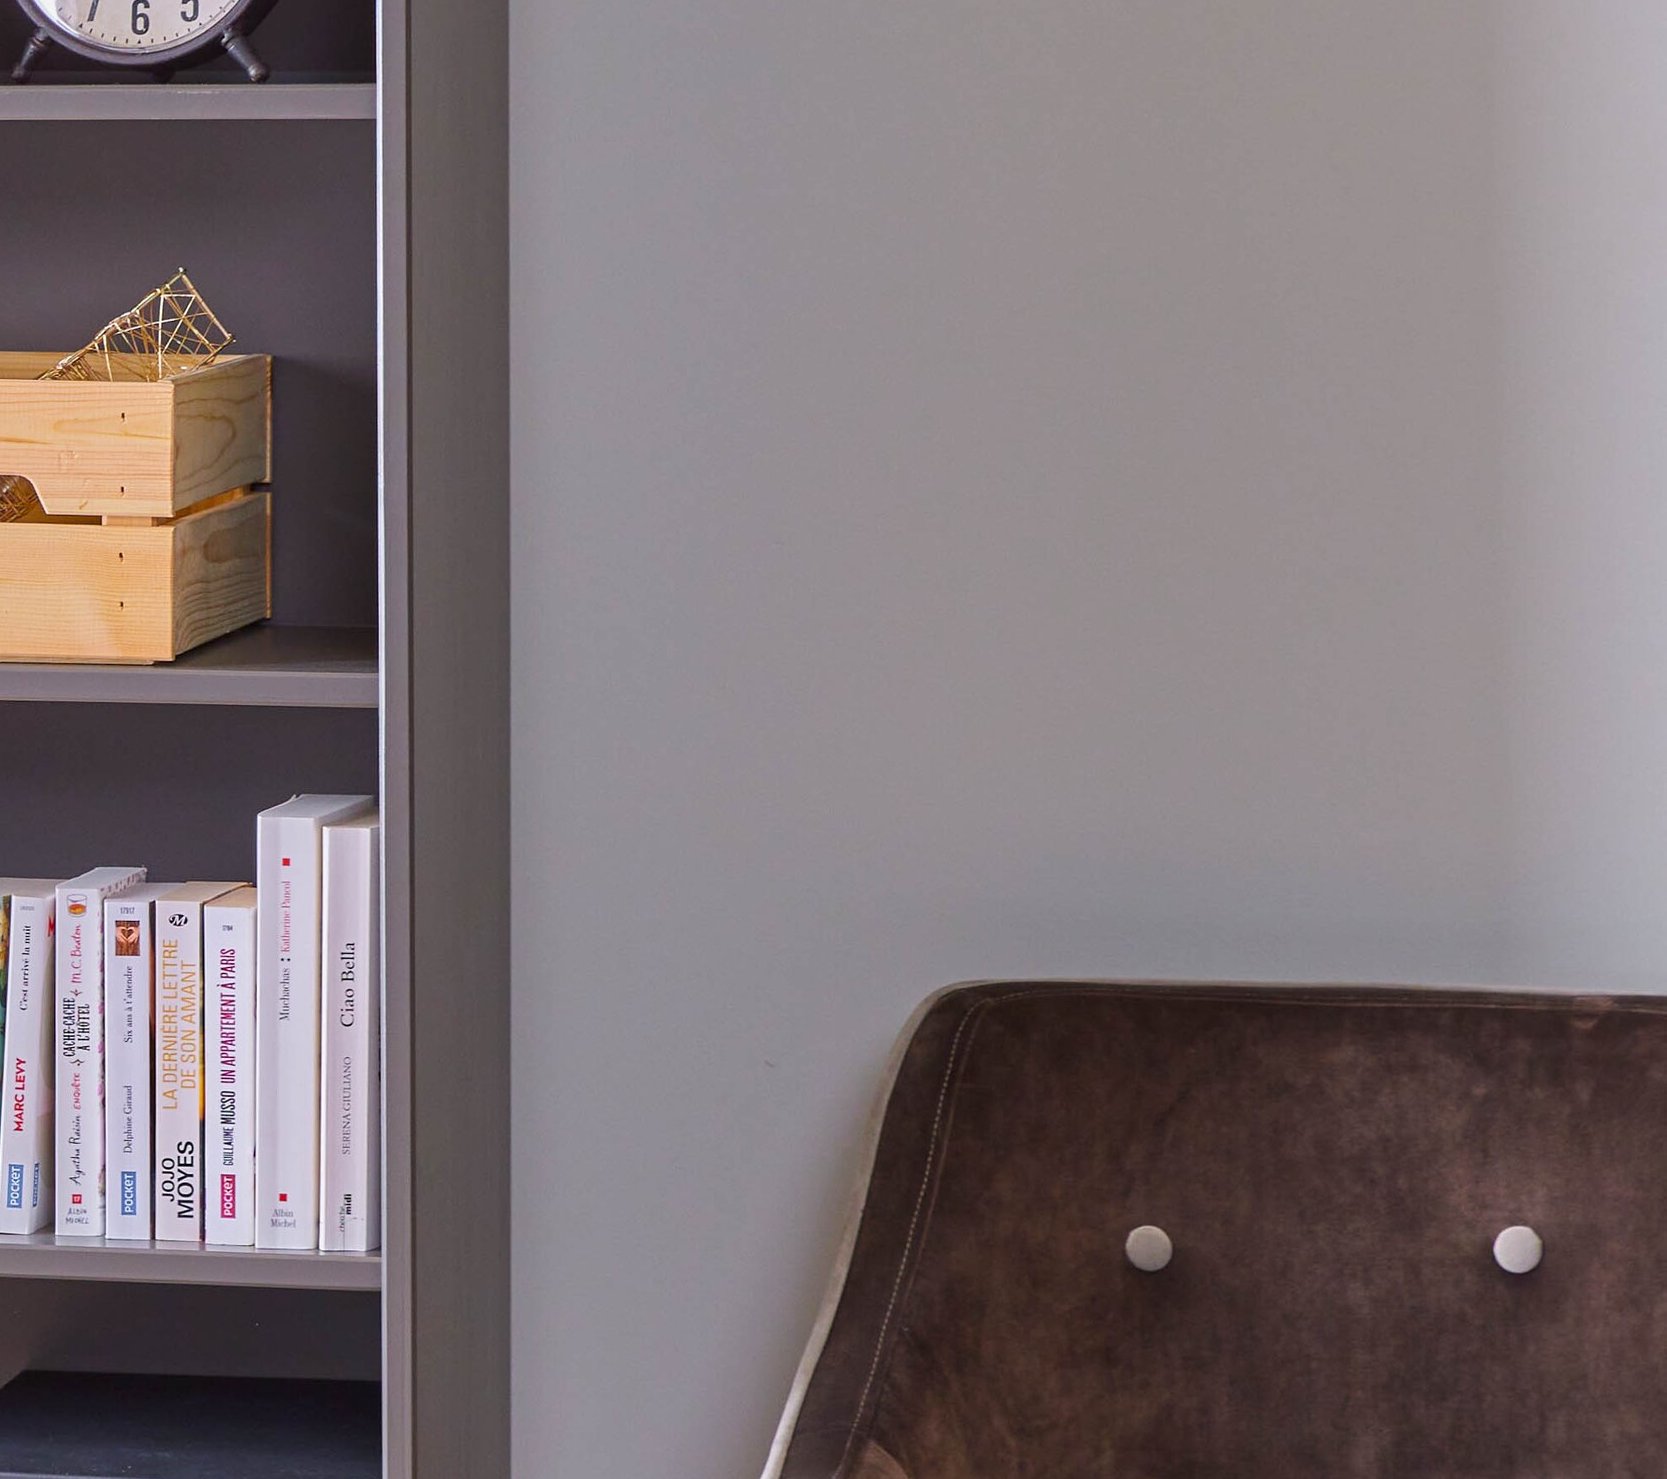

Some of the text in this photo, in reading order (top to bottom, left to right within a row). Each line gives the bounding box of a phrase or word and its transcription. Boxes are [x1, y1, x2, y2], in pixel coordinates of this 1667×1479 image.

[340, 942, 356, 1027] Ciao Bella
[63, 997, 76, 1057] CACHE-CACHE
[161, 939, 178, 1110] LA DERNIÈRE LETTRE
[180, 960, 196, 1090] DE SON AMANT
[217, 948, 236, 1166] GUILLAUME MUSSO UN APPARTEMENT À PARIS
[14, 1057, 26, 1131] MARC LEVY
[123, 1085, 133, 1153] Delphine Giraud
[342, 1056, 352, 1155] SERENA GIULIANO
[162, 1157, 175, 1202] JOJO
[177, 1141, 194, 1219] MOYES
[272, 1209, 294, 1217] Albin
[270, 1219, 296, 1228] Michel
